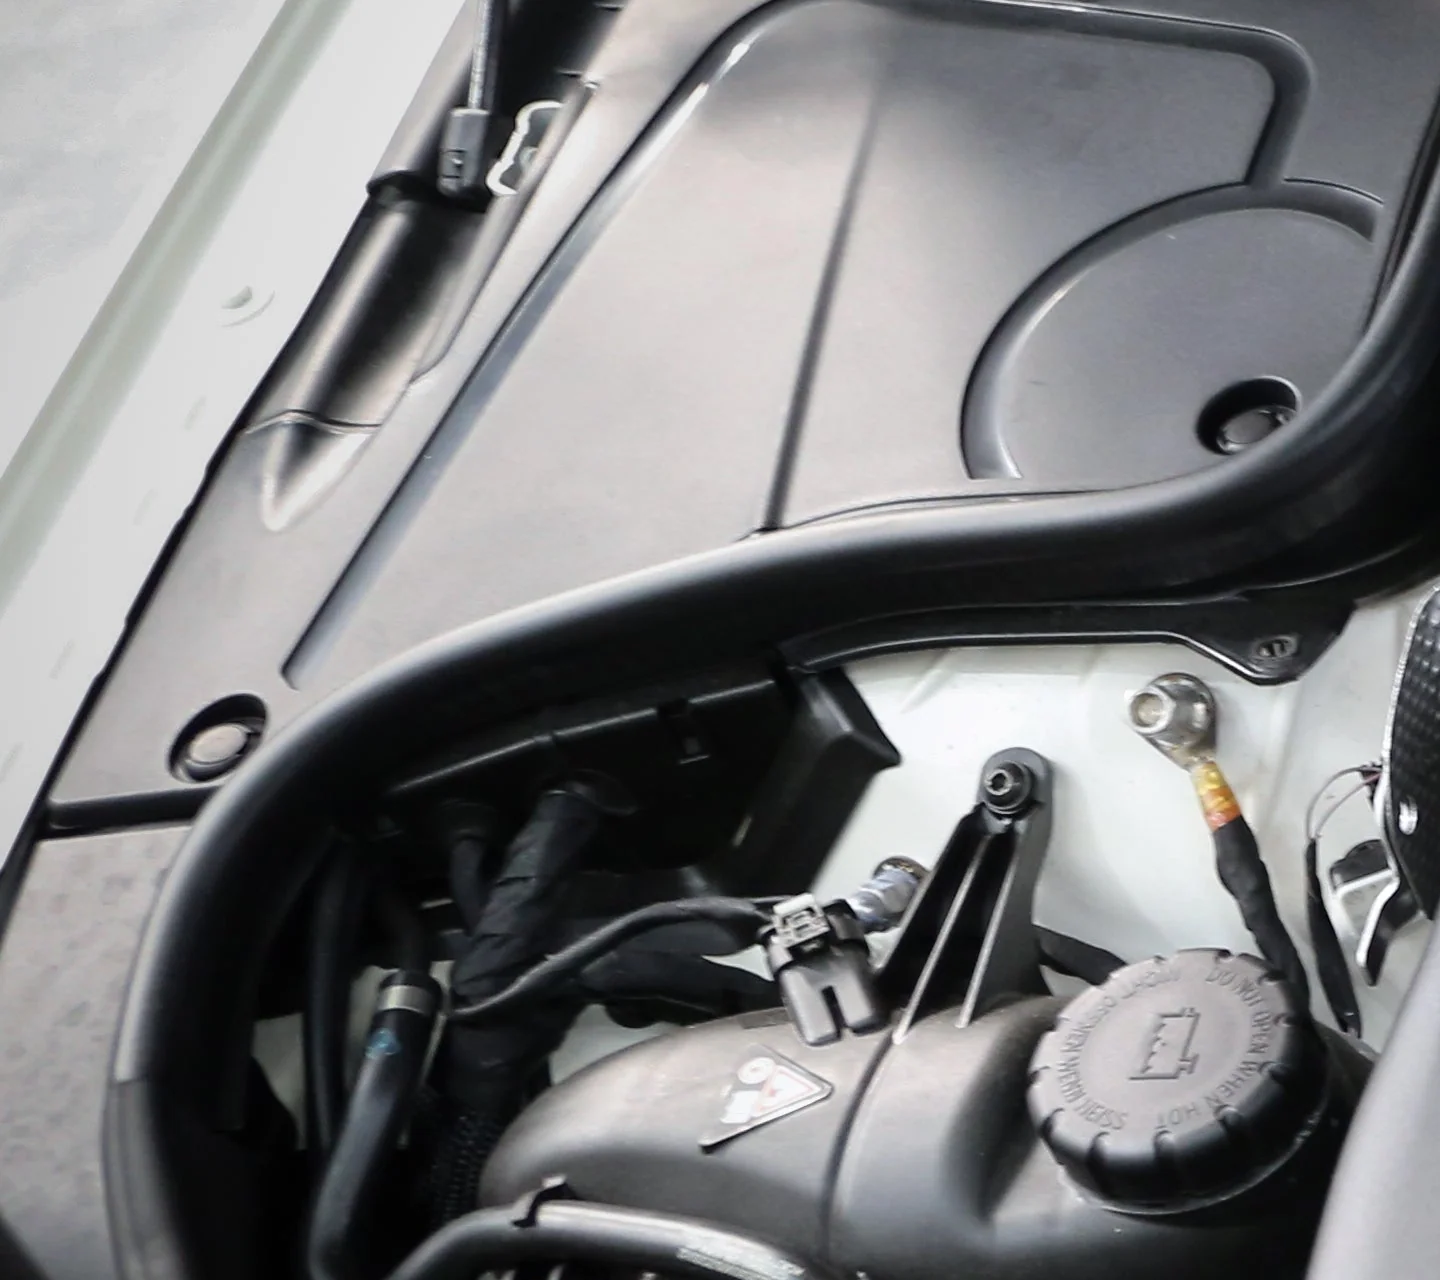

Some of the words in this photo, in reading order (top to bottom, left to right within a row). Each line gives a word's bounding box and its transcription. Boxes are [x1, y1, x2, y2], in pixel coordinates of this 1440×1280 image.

[1247, 1010, 1273, 1055] OPEN
[1205, 1058, 1260, 1111] WHEN
[1155, 1101, 1200, 1130] HOT
